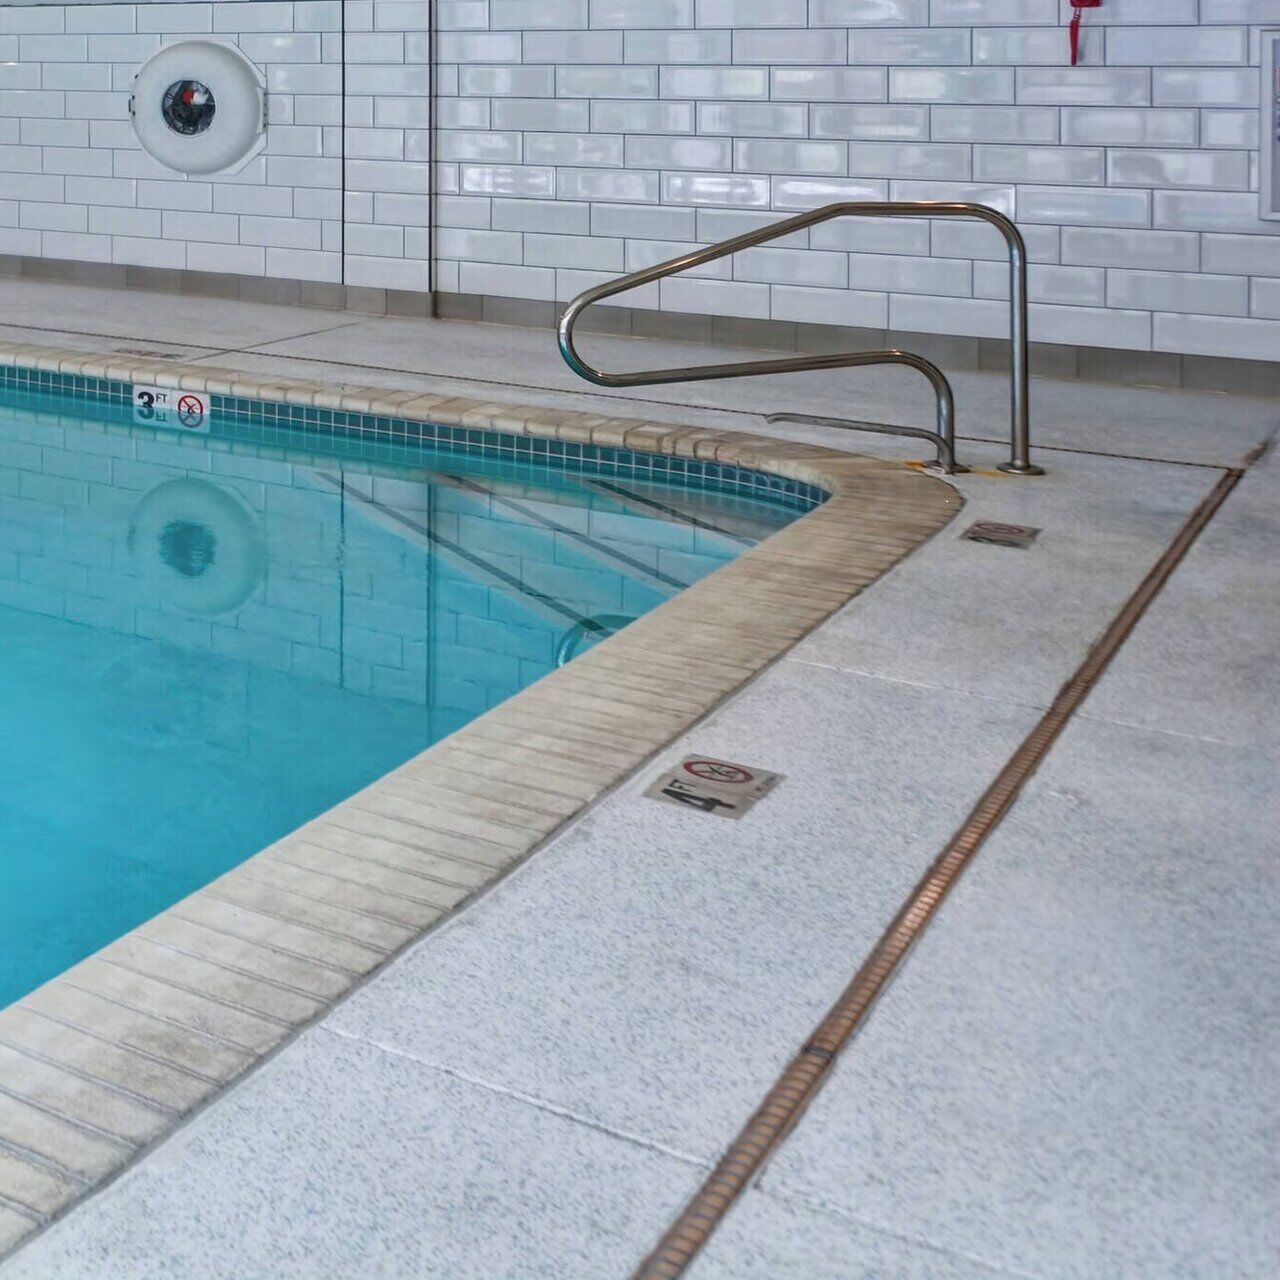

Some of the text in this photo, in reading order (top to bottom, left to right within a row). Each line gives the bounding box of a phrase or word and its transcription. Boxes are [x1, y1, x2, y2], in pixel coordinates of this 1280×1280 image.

[137, 391, 168, 408] 3 FT
[668, 779, 697, 792] FT
[661, 788, 737, 812] 4
